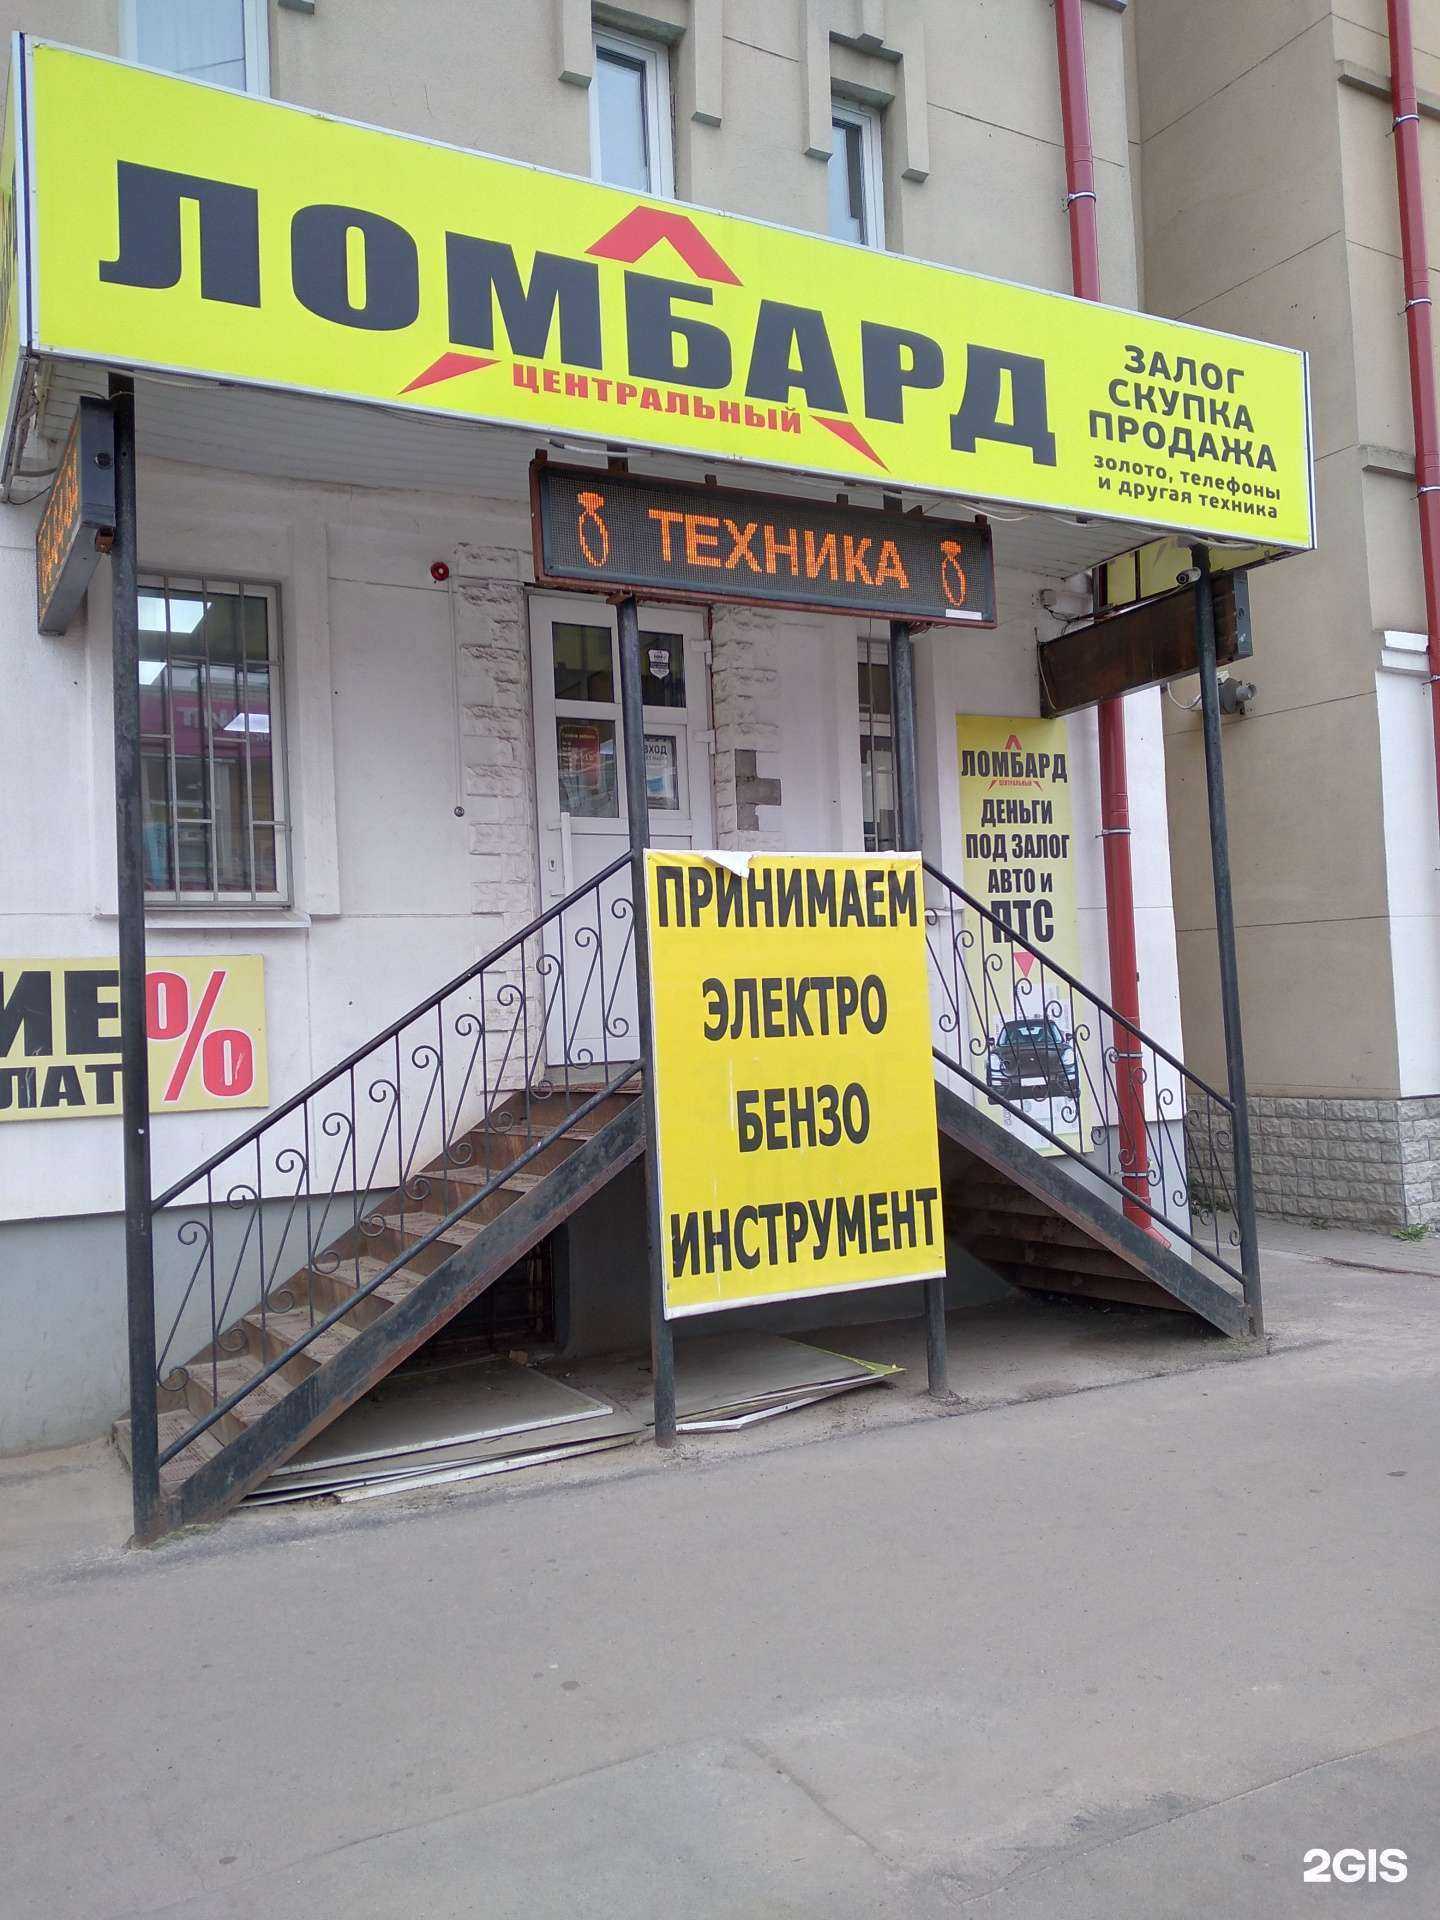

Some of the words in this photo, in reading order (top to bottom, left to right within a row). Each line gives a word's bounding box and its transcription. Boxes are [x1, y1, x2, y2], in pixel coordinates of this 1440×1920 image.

[99, 160, 1056, 466] ЛОМБАРД
[1124, 345, 1244, 393] ЗАЛОГ
[513, 363, 801, 434] ЦЕНТРАЛЬНЫЙ
[1108, 378, 1254, 432] СКУПКА
[1089, 409, 1277, 471] ПРОДАЖА
[1094, 455, 1173, 483] золото,
[1180, 471, 1280, 500] телефоны
[1098, 476, 1111, 490] и
[1119, 481, 1192, 503] другая
[1199, 494, 1277, 518] техника
[648, 508, 909, 589] ТЕХНИКА
[961, 750, 1068, 783] ЛОМБАРД
[981, 799, 1053, 827] ДЕНЬГИ
[966, 833, 1008, 862] ПОД
[1011, 833, 1070, 859] ЗАЛОГ
[656, 866, 918, 928] ПРИНИМАЕМ
[988, 868, 1036, 893] АВТО
[990, 899, 1054, 943] ПТС
[702, 974, 888, 1041] ЭЛЕКТРО
[736, 1082, 871, 1153] БЕНЗО
[671, 1187, 938, 1278] ИНСТРУМЕНТ
